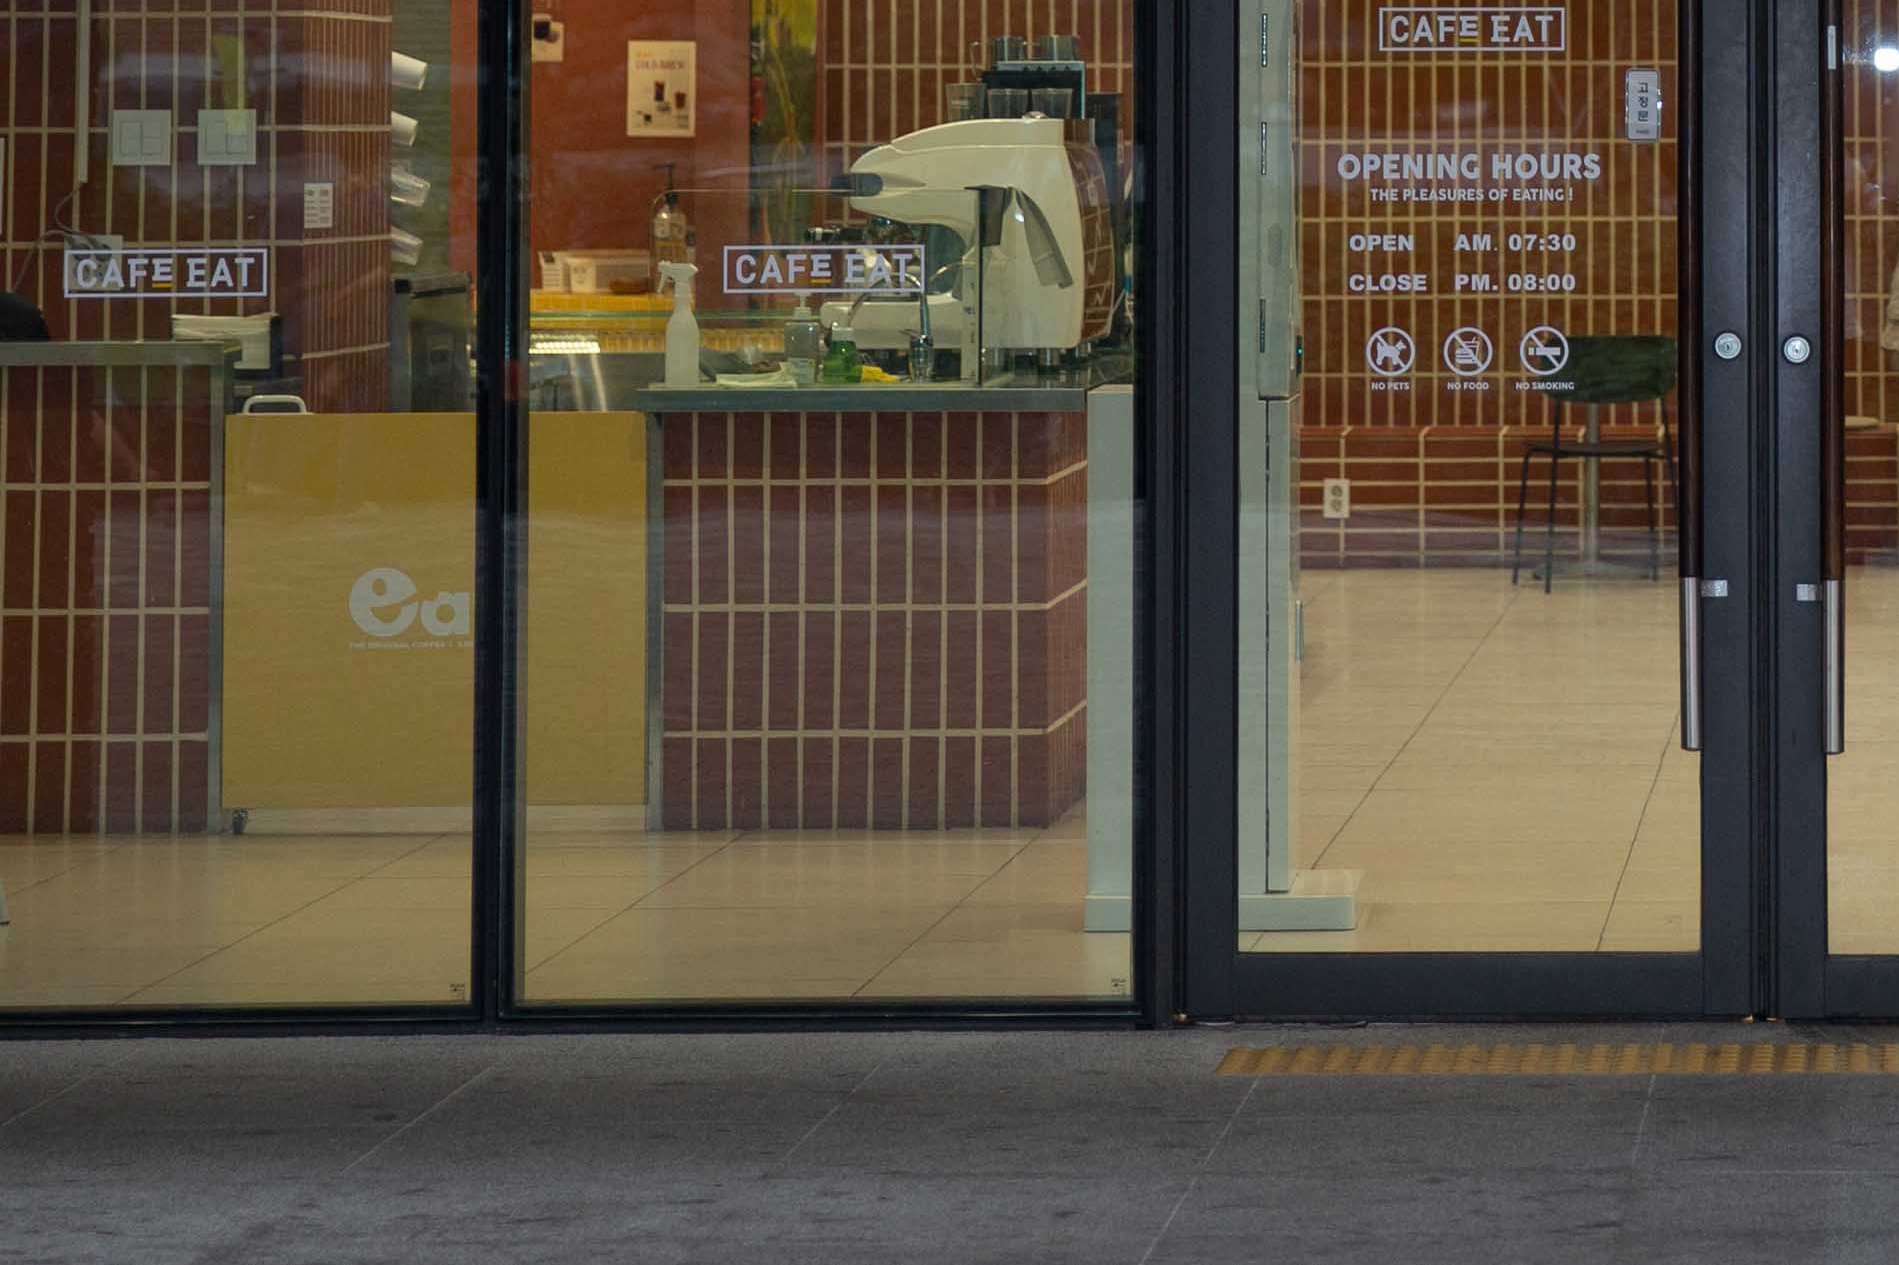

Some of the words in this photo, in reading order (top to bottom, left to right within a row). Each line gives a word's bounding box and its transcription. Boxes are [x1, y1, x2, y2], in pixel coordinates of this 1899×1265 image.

[1390, 15, 1479, 43] CAFE
[1490, 15, 1554, 43] EAT
[1637, 81, 1649, 122] 고정문
[1337, 153, 1480, 180] OPENING
[1492, 153, 1601, 180] HOURS
[1371, 188, 1399, 201] THE
[1403, 188, 1484, 201] PLEASURES
[1488, 188, 1508, 201] OF
[1513, 188, 1565, 201] EATING
[1349, 234, 1415, 252] OPEN
[1454, 234, 1499, 252] AM.
[1508, 234, 1576, 252] 07:30
[75, 256, 174, 288] CAFE
[187, 256, 256, 288] EAT
[735, 254, 832, 284] CAFE
[845, 254, 913, 284] EAT
[1349, 274, 1427, 292] CLOSE
[1455, 274, 1498, 292] PM.
[1508, 274, 1576, 292] 08:00
[1371, 381, 1386, 391] NO
[1387, 381, 1410, 391] PETS
[1447, 381, 1462, 391] NO
[1463, 381, 1489, 391] FOOD
[1515, 381, 1530, 391] NO
[1532, 381, 1575, 391] SMOKING
